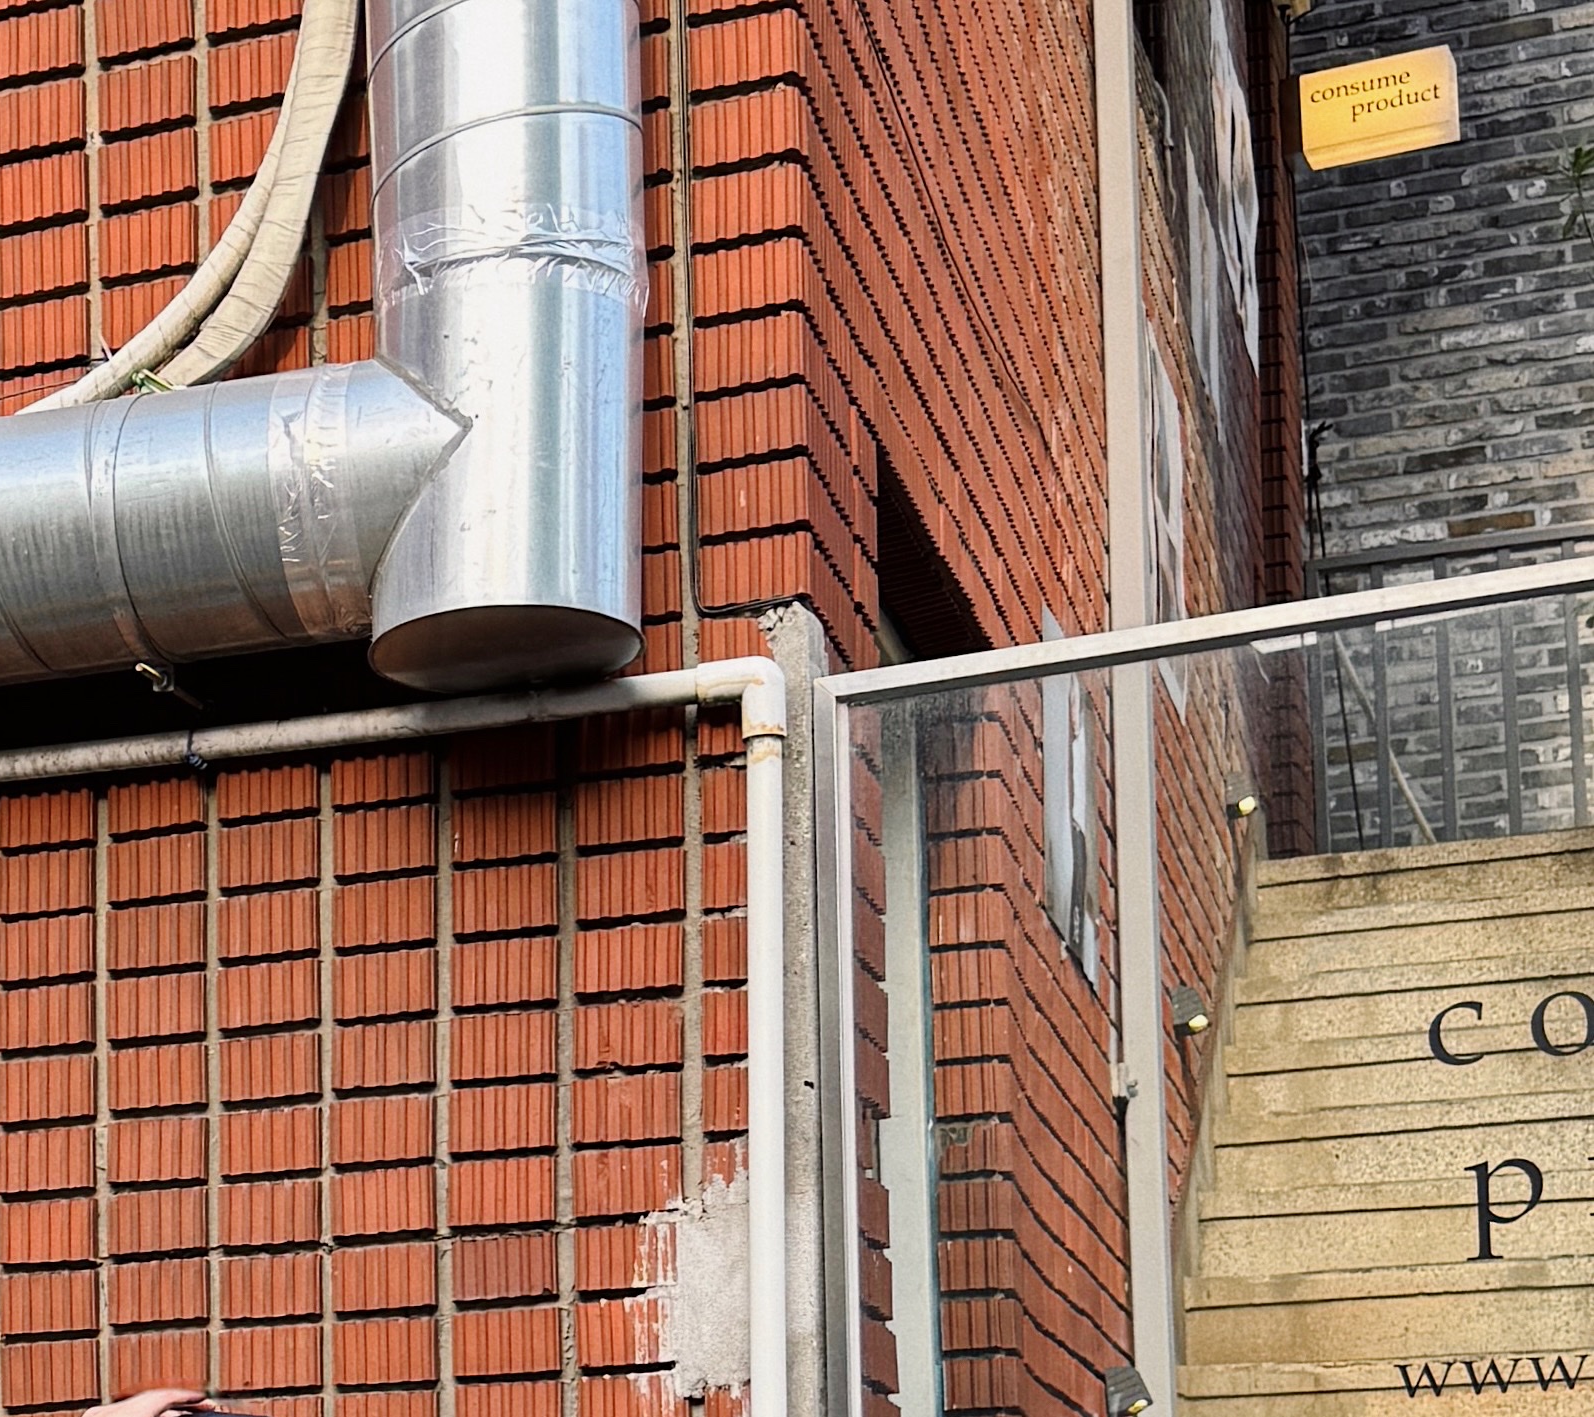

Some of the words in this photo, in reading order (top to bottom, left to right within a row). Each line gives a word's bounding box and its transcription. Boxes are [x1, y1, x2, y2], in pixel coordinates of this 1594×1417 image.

[1310, 71, 1410, 103] consume
[1351, 83, 1441, 122] product
[1428, 991, 1594, 1066] co
[1393, 1354, 1589, 1398] www
